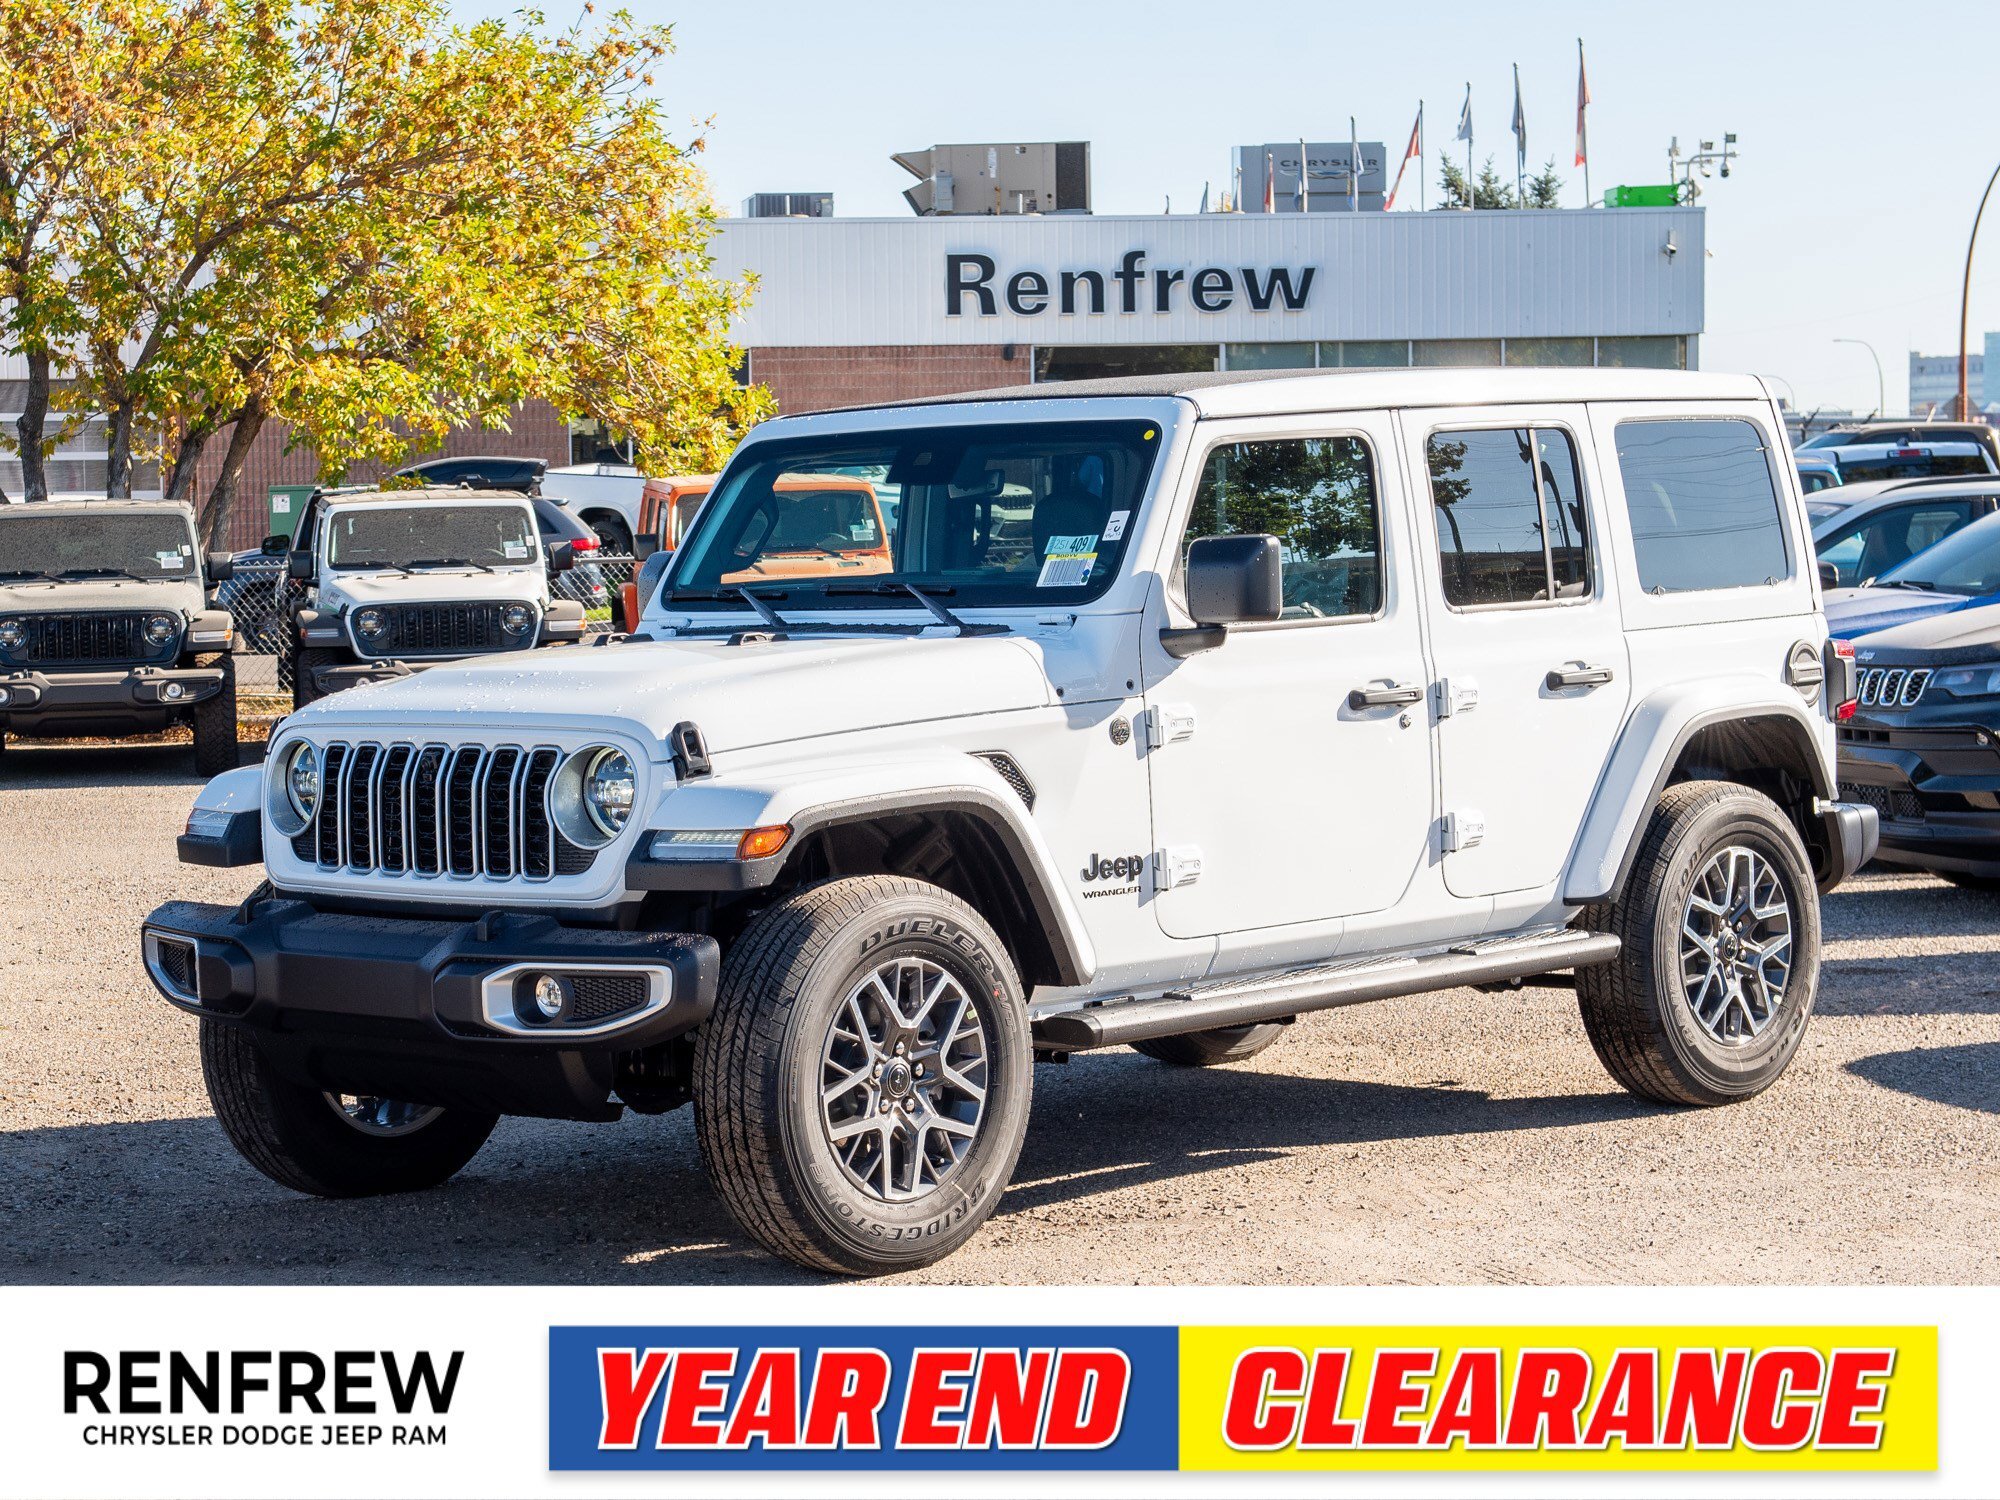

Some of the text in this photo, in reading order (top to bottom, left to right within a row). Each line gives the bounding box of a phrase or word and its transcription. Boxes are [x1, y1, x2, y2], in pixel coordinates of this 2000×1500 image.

[946, 249, 1317, 316] Renfrew
[1069, 536, 1089, 552] 409
[1081, 852, 1144, 883] Jeep
[1082, 885, 1142, 899] WRANGLER
[858, 917, 995, 978] DUELER
[809, 1162, 987, 1242] BRIDGESTONE
